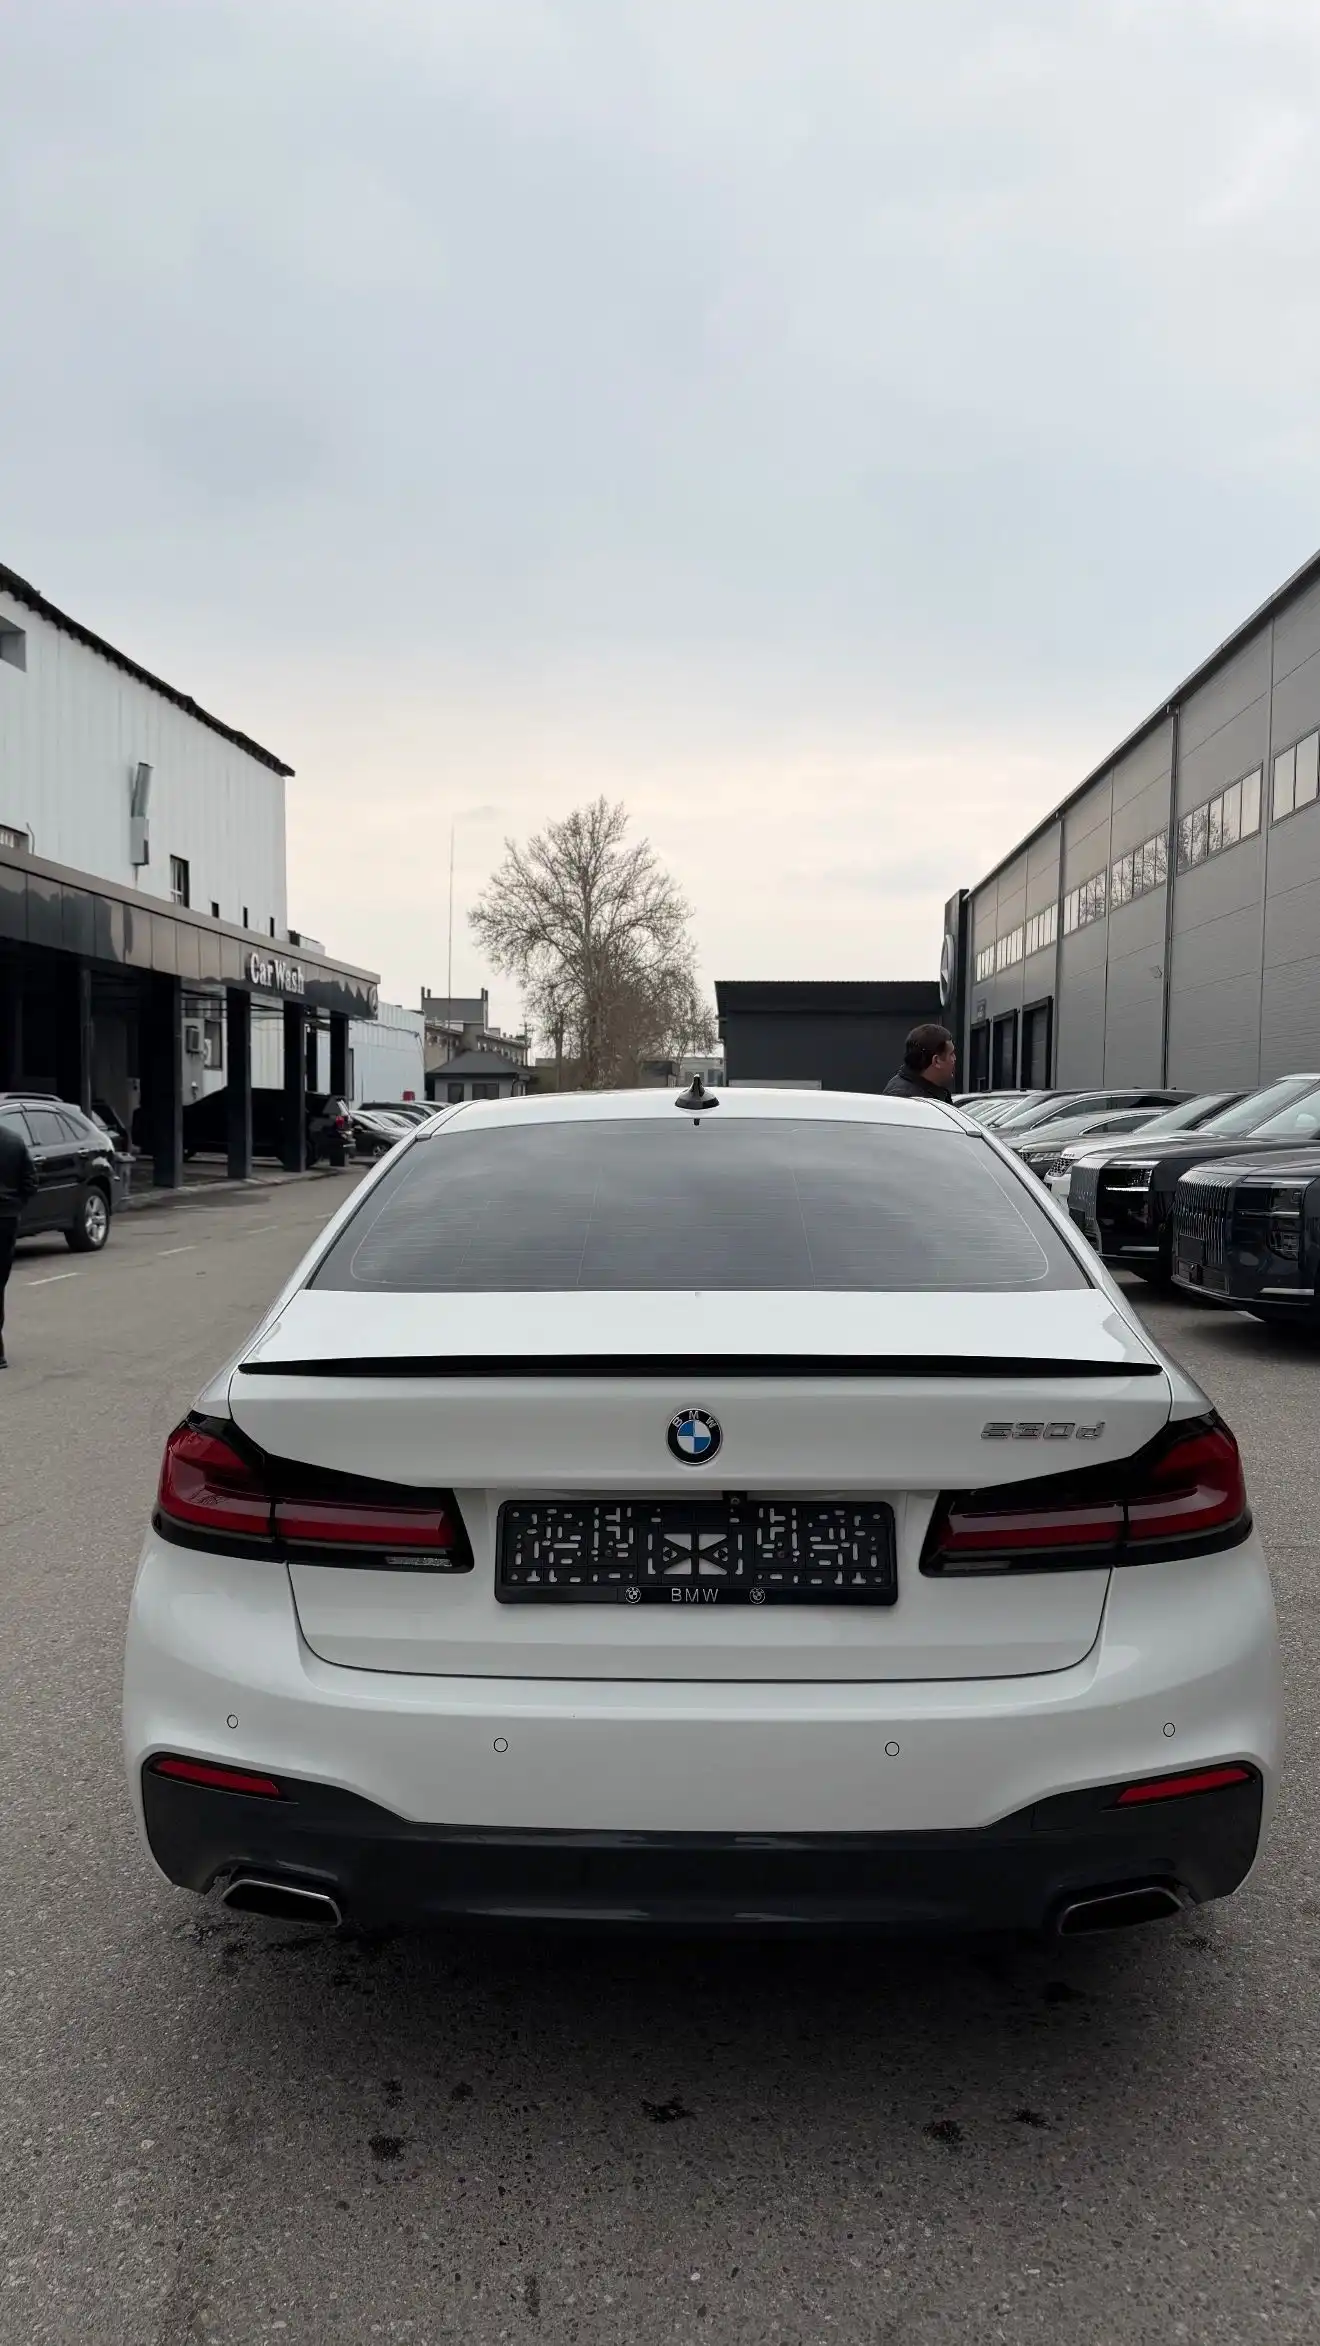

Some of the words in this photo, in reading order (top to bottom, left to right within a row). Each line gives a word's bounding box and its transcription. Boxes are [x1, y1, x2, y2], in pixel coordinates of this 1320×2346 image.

[250, 952, 273, 987] Car
[274, 960, 305, 995] Wash
[672, 1410, 717, 1428] BMW
[980, 1421, 1106, 1439] 530d
[671, 1587, 719, 1602] BMW
